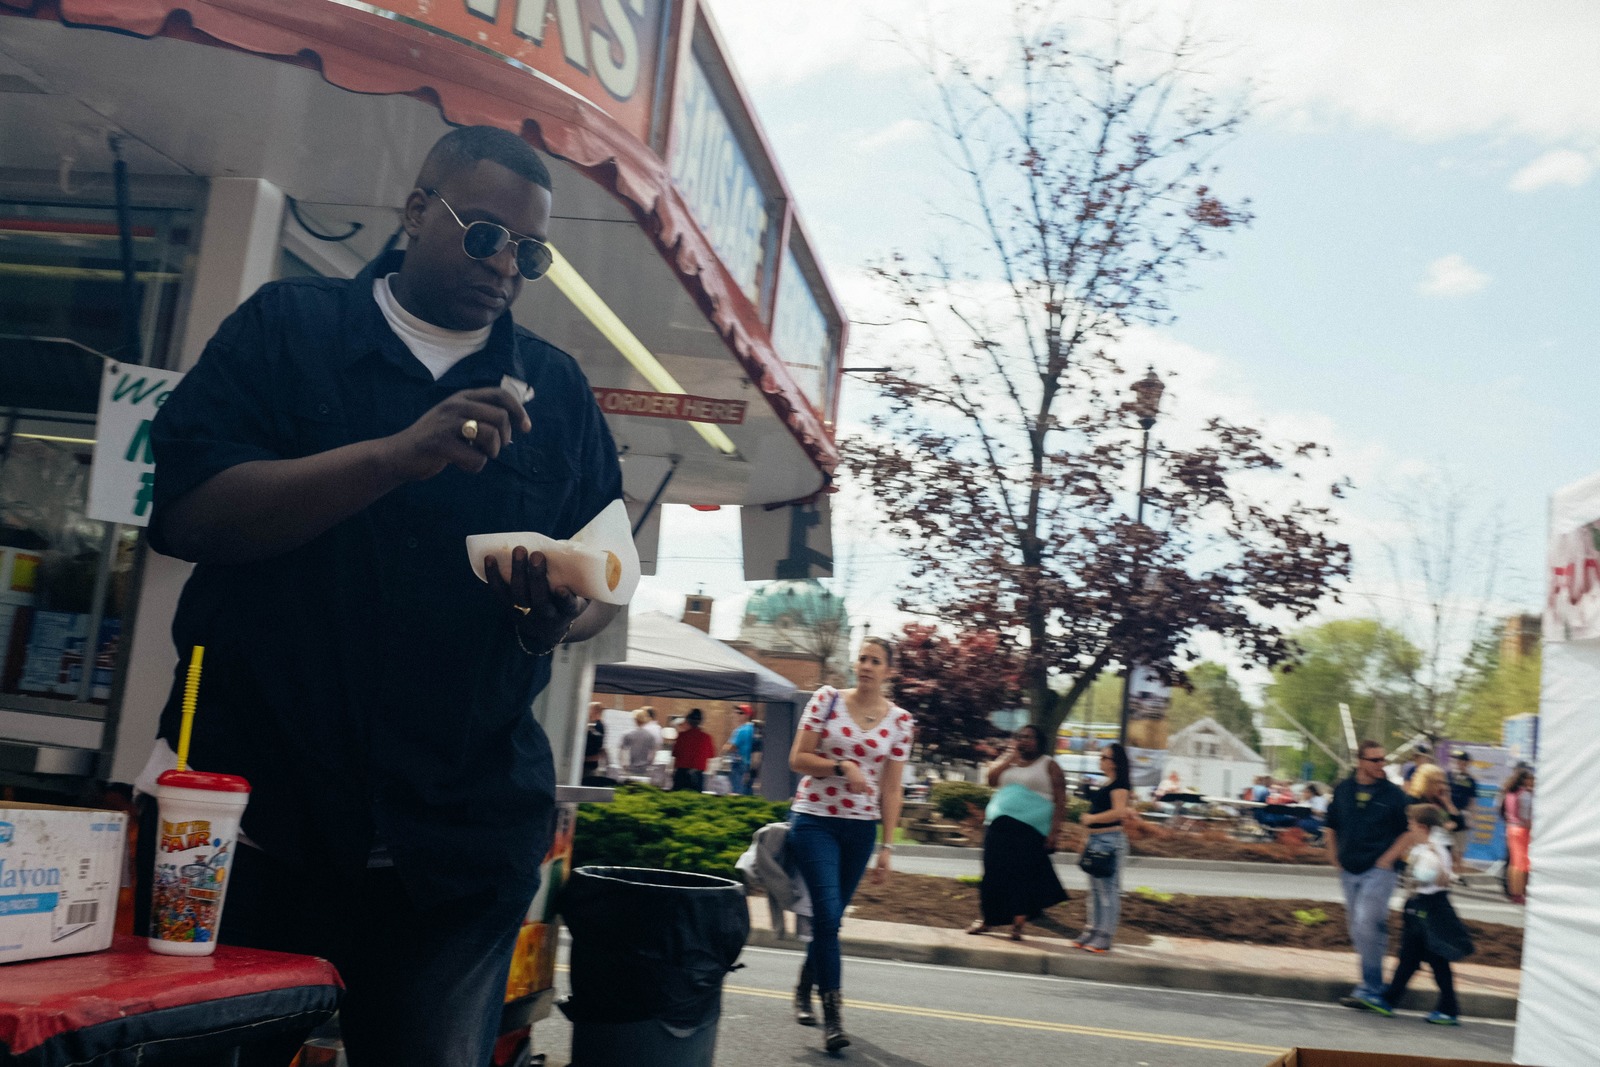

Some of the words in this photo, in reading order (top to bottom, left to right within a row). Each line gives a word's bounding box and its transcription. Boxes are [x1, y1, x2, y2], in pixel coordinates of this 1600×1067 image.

[604, 392, 679, 415] ORDER
[681, 399, 744, 421] HERE
[160, 831, 212, 853] FAIR
[0, 858, 60, 892] ayon
